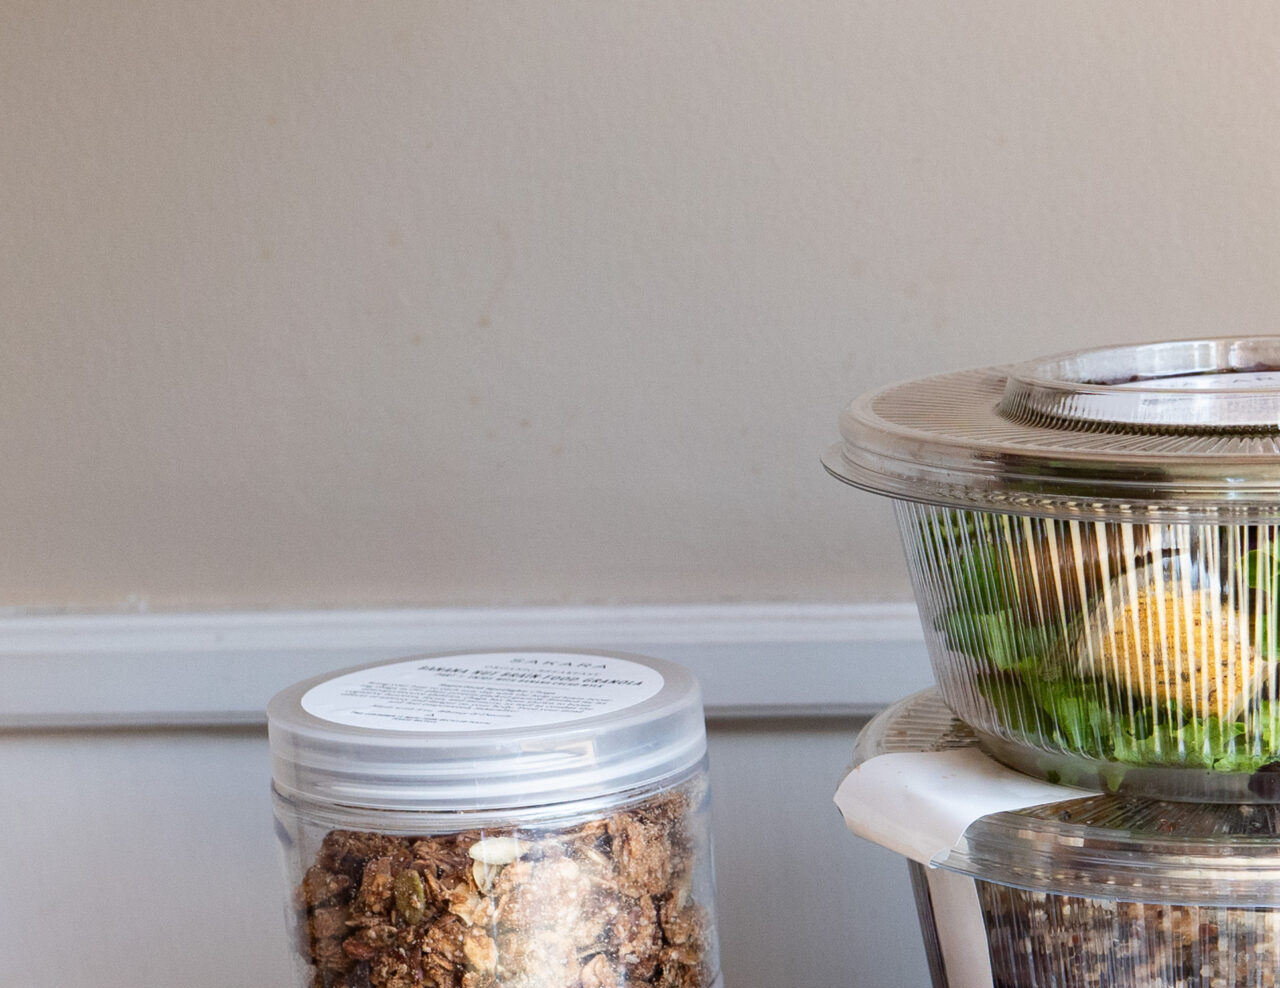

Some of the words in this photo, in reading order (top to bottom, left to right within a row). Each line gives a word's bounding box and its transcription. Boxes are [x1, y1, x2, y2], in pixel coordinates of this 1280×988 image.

[510, 657, 607, 670] SAKARA
[417, 665, 468, 674] BANANA
[582, 678, 644, 686] GRANOLA
